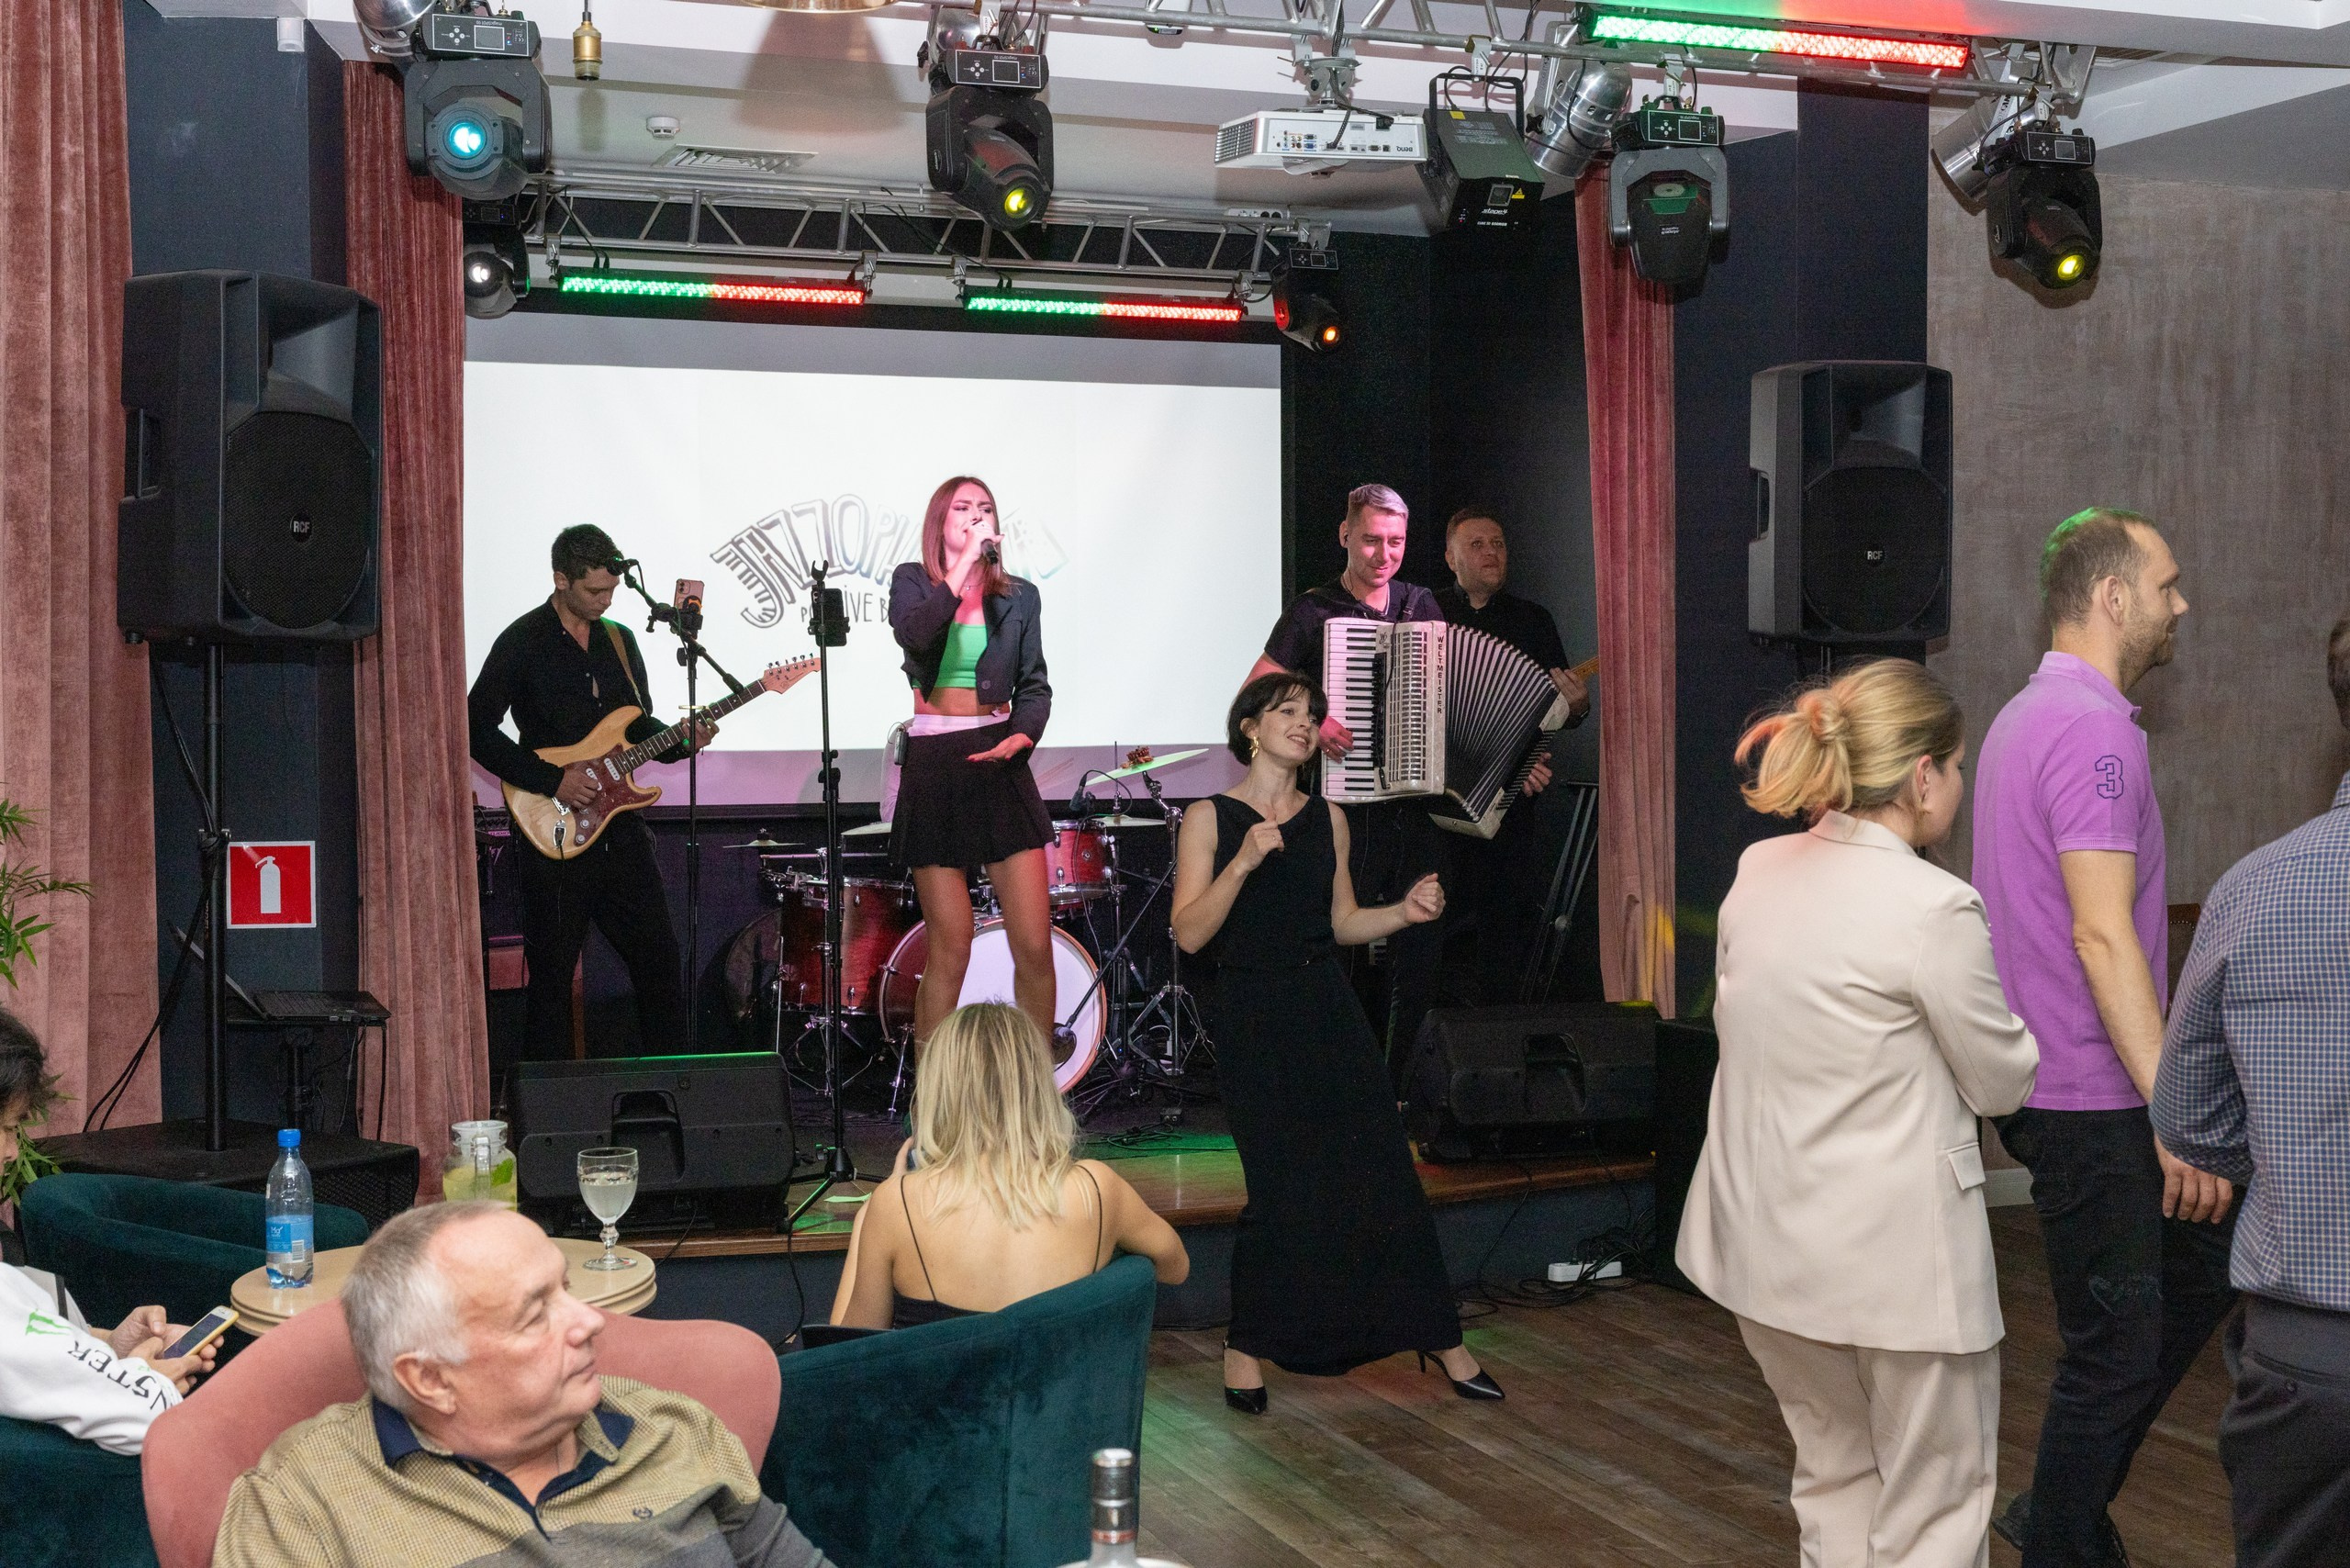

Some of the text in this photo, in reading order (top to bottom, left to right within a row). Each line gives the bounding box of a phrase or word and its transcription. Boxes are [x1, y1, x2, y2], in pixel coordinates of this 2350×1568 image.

[293, 521, 310, 533] RCF
[1866, 550, 1884, 560] RCF
[1437, 635, 1445, 714] WELTMEISTER
[2094, 754, 2124, 800] 3
